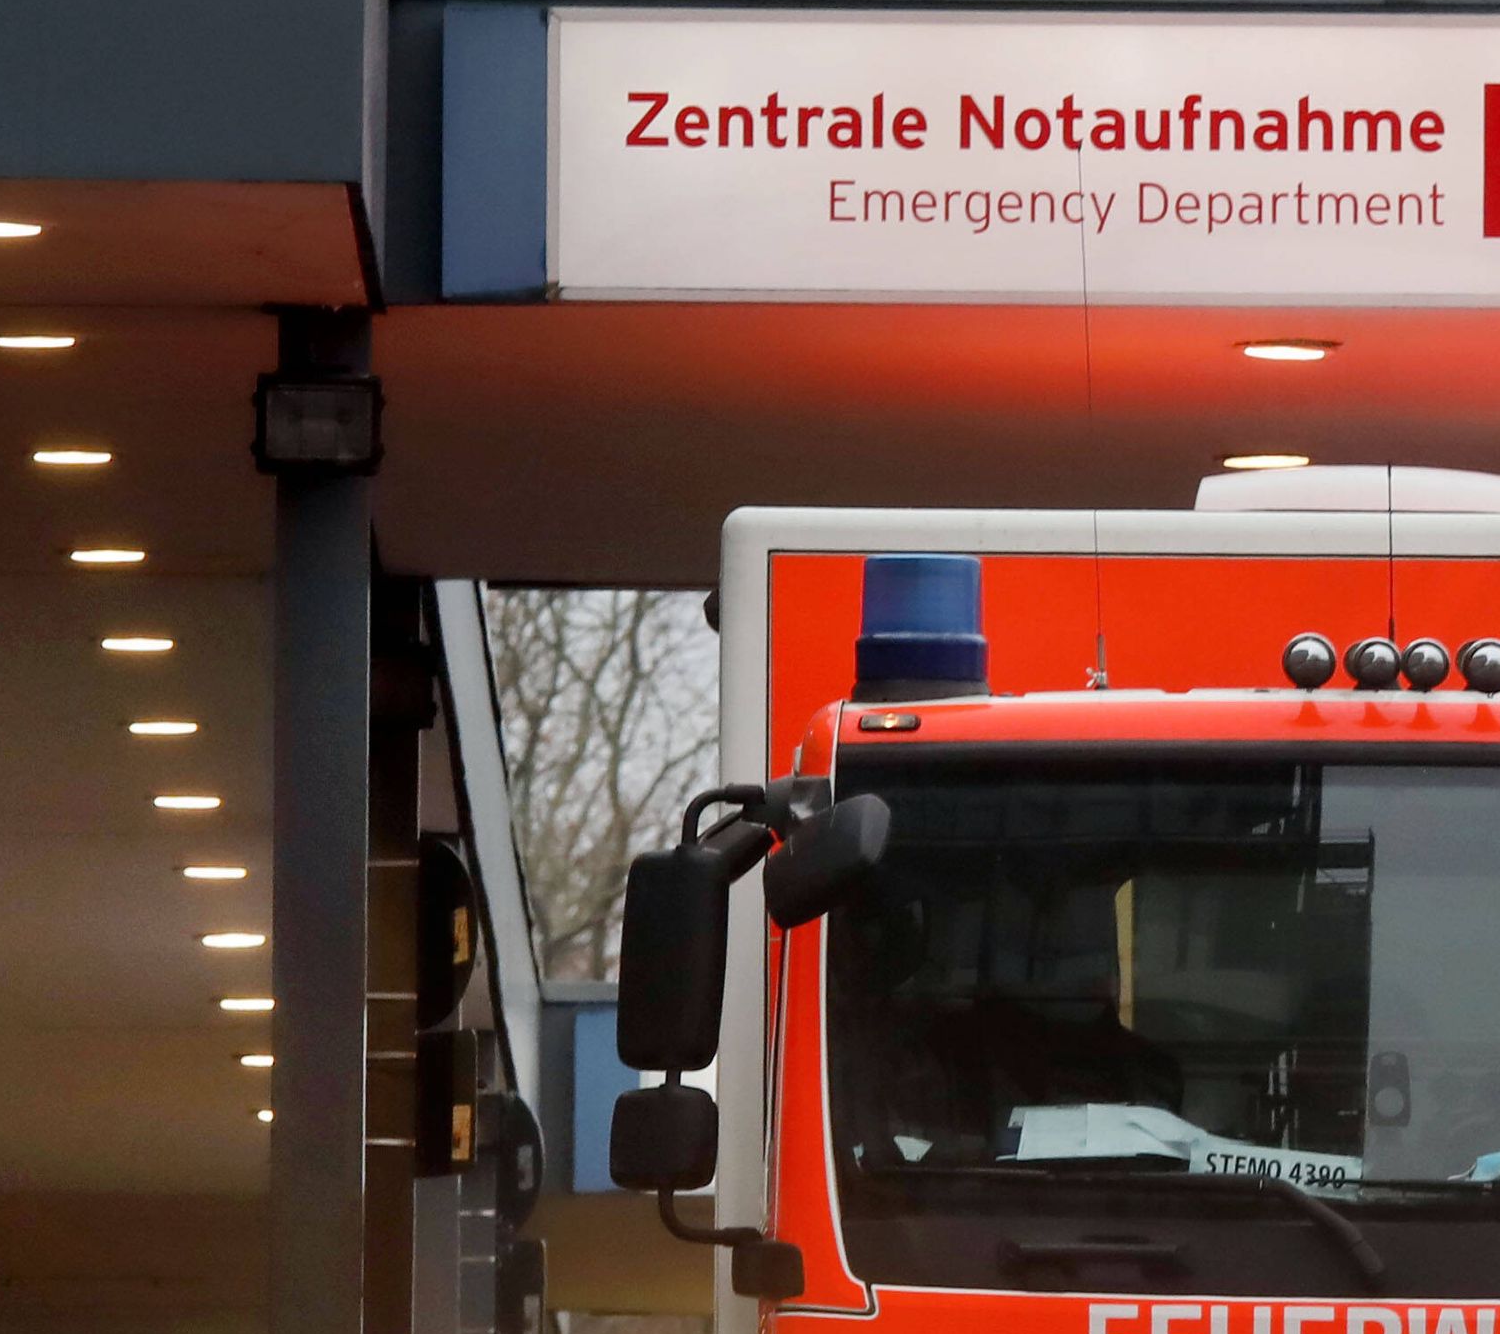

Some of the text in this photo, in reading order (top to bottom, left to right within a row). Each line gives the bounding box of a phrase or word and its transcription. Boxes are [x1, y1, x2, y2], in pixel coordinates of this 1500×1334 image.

[624, 90, 1447, 153] Zentrale Notaufnahme
[828, 179, 1447, 234] Emergency Department
